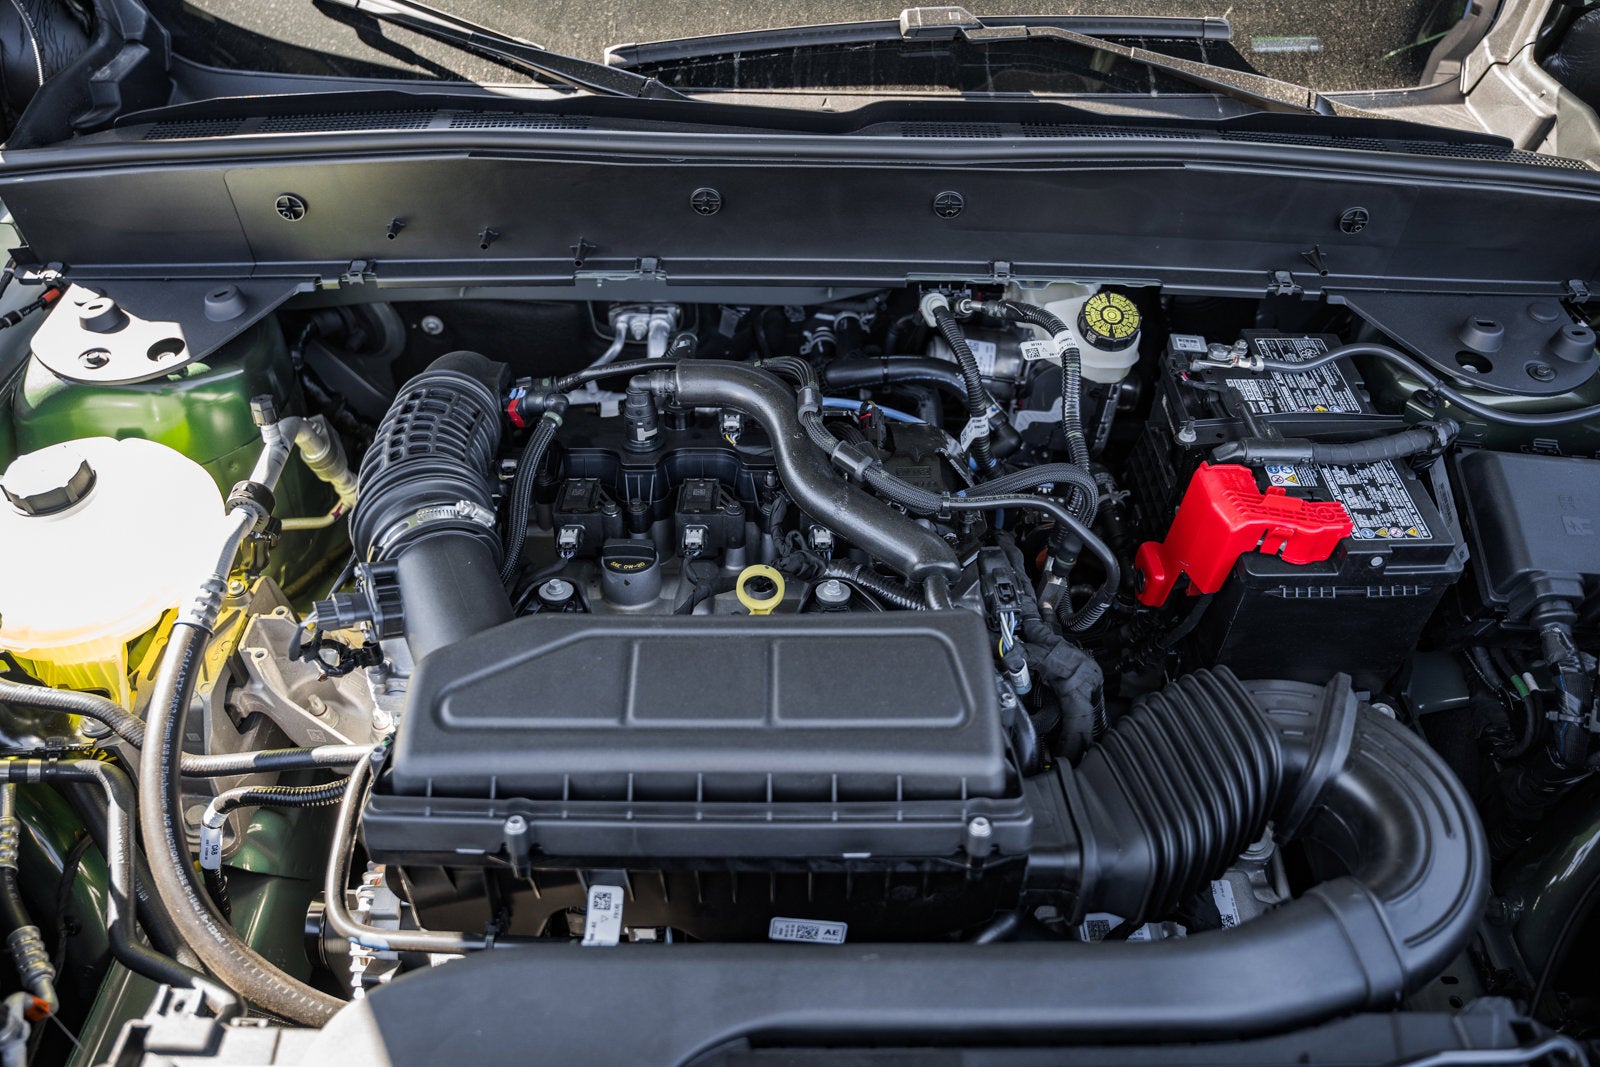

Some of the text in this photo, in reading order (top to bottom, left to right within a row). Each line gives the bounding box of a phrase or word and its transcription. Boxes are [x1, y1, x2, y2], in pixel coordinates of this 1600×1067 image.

[176, 648, 193, 691] GALAXY
[163, 813, 171, 827] A/C
[165, 827, 180, 864] SUCTION
[174, 863, 189, 886] HOSE
